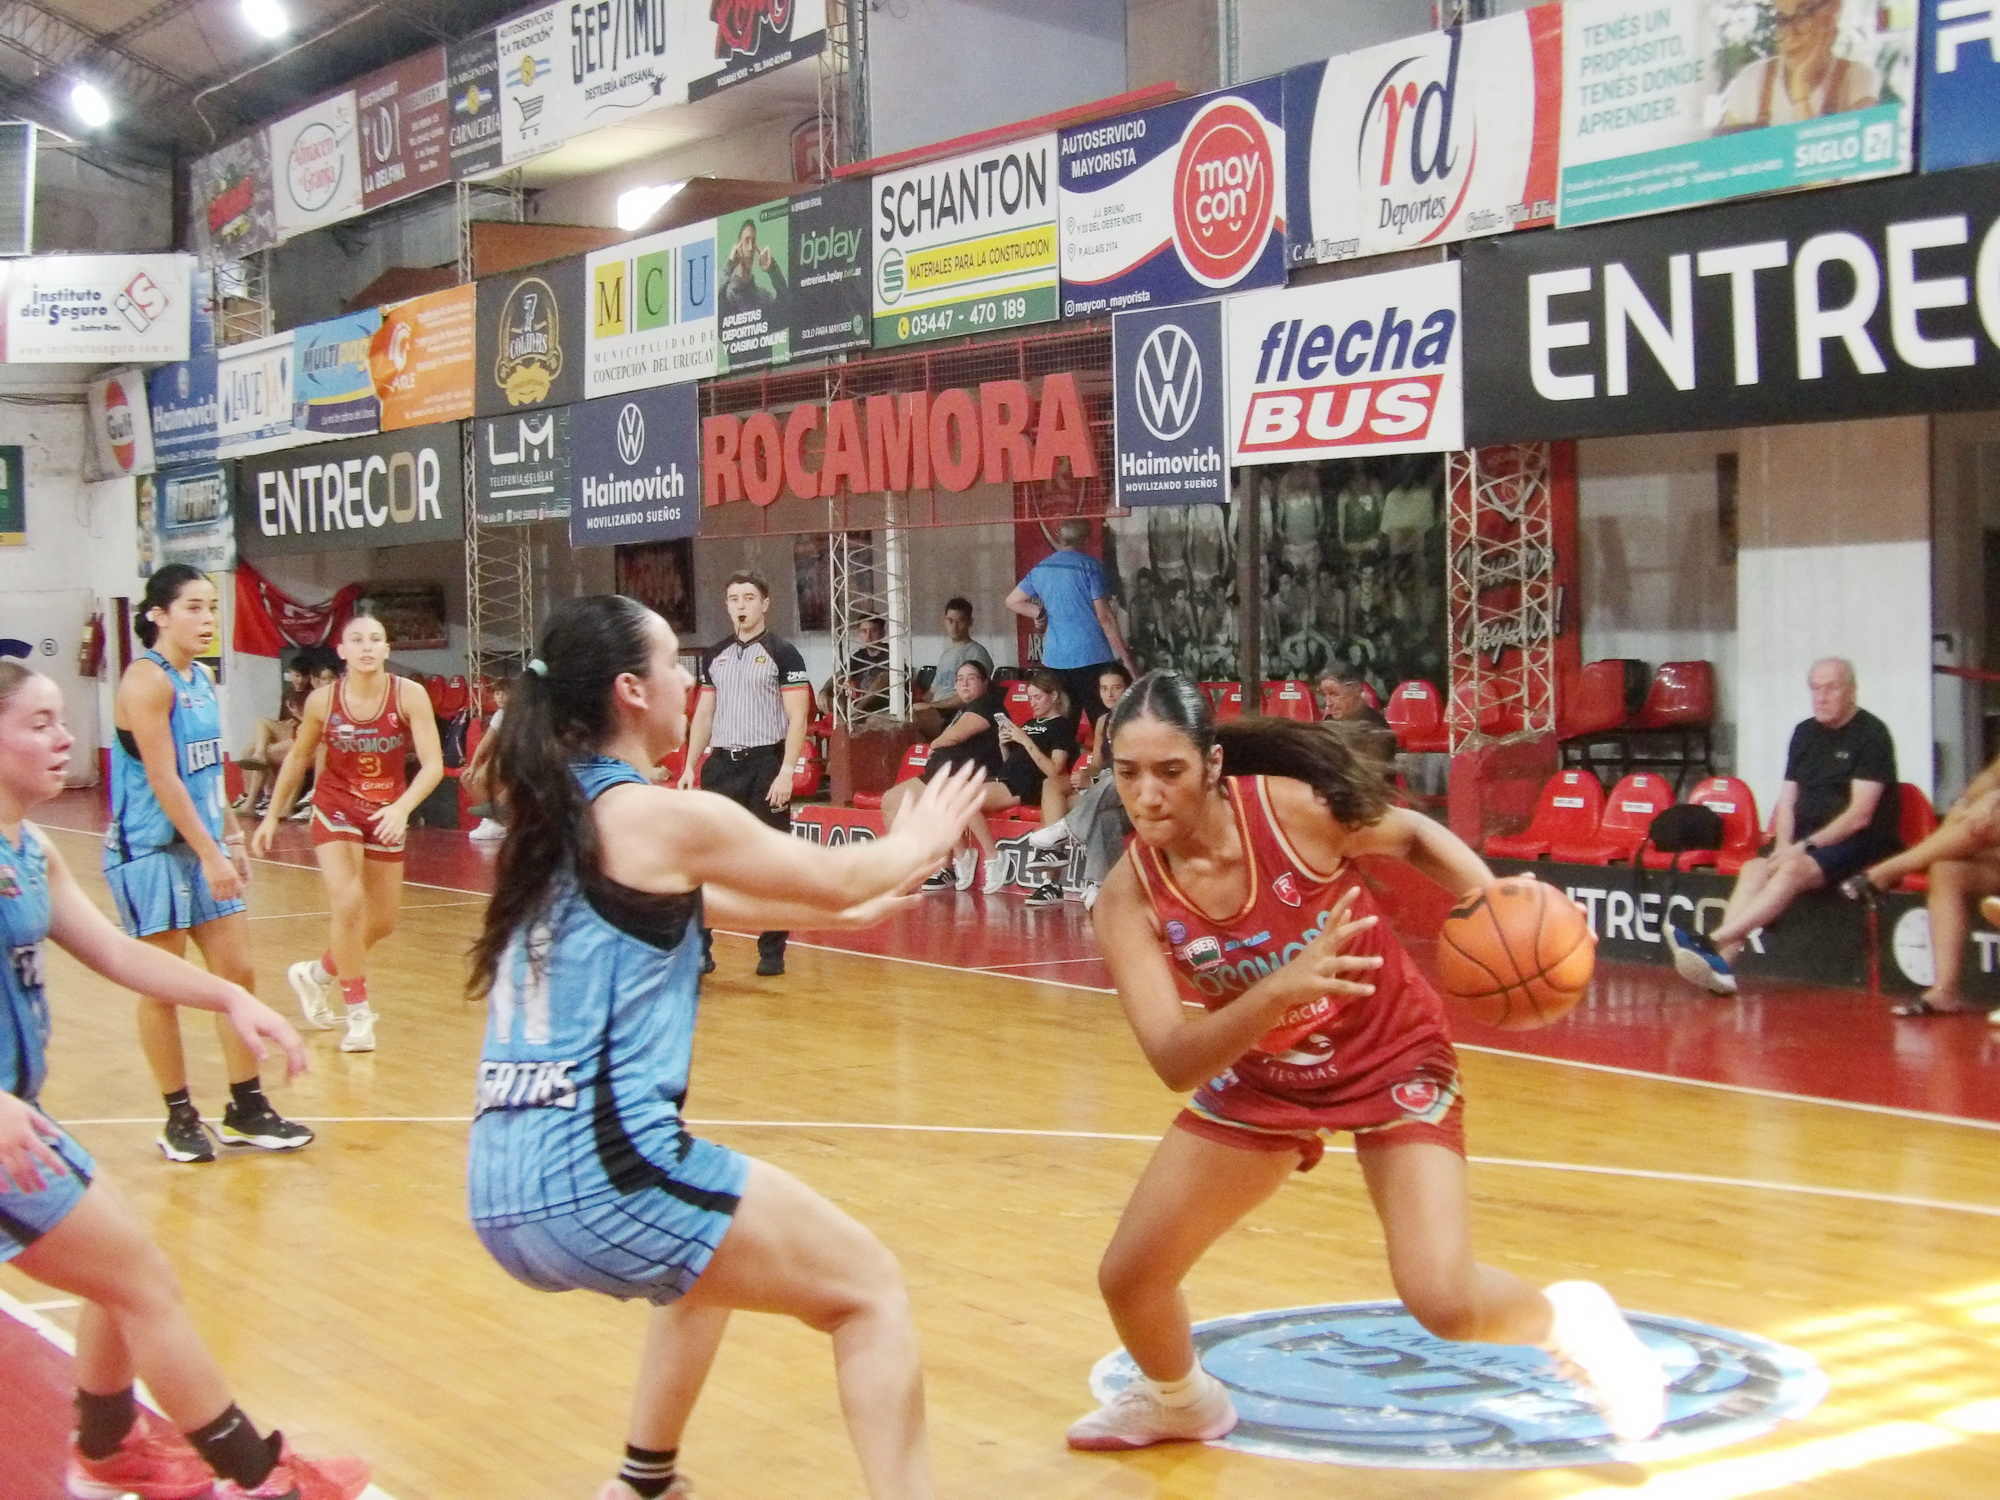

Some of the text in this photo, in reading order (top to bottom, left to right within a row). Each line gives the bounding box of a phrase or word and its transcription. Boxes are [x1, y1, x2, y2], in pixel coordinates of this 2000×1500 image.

[1582, 9, 1671, 48] TENÉS UN
[1579, 59, 1706, 106] TENÉS DONDE
[1378, 25, 1462, 187] rd
[1061, 119, 1148, 157] AUTOSERVICIO
[1794, 136, 1860, 168] SIGLO
[1071, 147, 1138, 179] MAYORISTA
[1196, 150, 1260, 191] may
[880, 148, 1048, 244] SCHANTON
[1104, 203, 1125, 216] BRUNO
[1196, 189, 1247, 226] con
[1379, 195, 1447, 234] Deportes
[1089, 221, 1101, 232] DEL
[1101, 217, 1121, 231] OESTE
[1121, 212, 1143, 226] NORTE
[801, 226, 863, 270] bplay
[909, 238, 1050, 282] MATERIALES PARA LA CONSTRUCCION
[32, 283, 102, 305] instituto
[598, 254, 711, 328] M C U
[1075, 289, 1151, 314] maycon_mayorista
[1528, 215, 2000, 402] ENTRE
[21, 304, 109, 326] del Seguro
[722, 309, 762, 329] APUESTAS
[722, 322, 768, 343] DEPORTIVAS
[801, 328, 815, 340] SOLO
[815, 325, 828, 337] PARA
[828, 321, 852, 335] MAYORES
[911, 308, 953, 337] 03447
[969, 303, 998, 325] 470
[1002, 297, 1027, 320] 189
[593, 330, 716, 364] MUNICIPALIDAD DE
[723, 342, 730, 356] Y
[731, 336, 760, 355] CASINO
[760, 331, 788, 347] ONLINE
[1255, 306, 1457, 385] flecha
[593, 361, 648, 385] CONCEPCION
[652, 356, 670, 373] DEL
[673, 346, 716, 370] URUGUAY
[1244, 382, 1432, 446] BUS
[703, 372, 1098, 508] ROCAMORA
[1121, 445, 1221, 477] Haimovich
[258, 447, 443, 537] ENTRECOR
[582, 463, 685, 508] Haimovich
[1125, 476, 1218, 493] MOVILIZANDO SUEÑOS
[587, 510, 644, 530] MOVILIZANDO
[646, 505, 681, 523] SUEÑOS
[358, 752, 382, 778] 3
[1185, 938, 1218, 960] FBER
[1268, 1064, 1339, 1083] TERMAS
